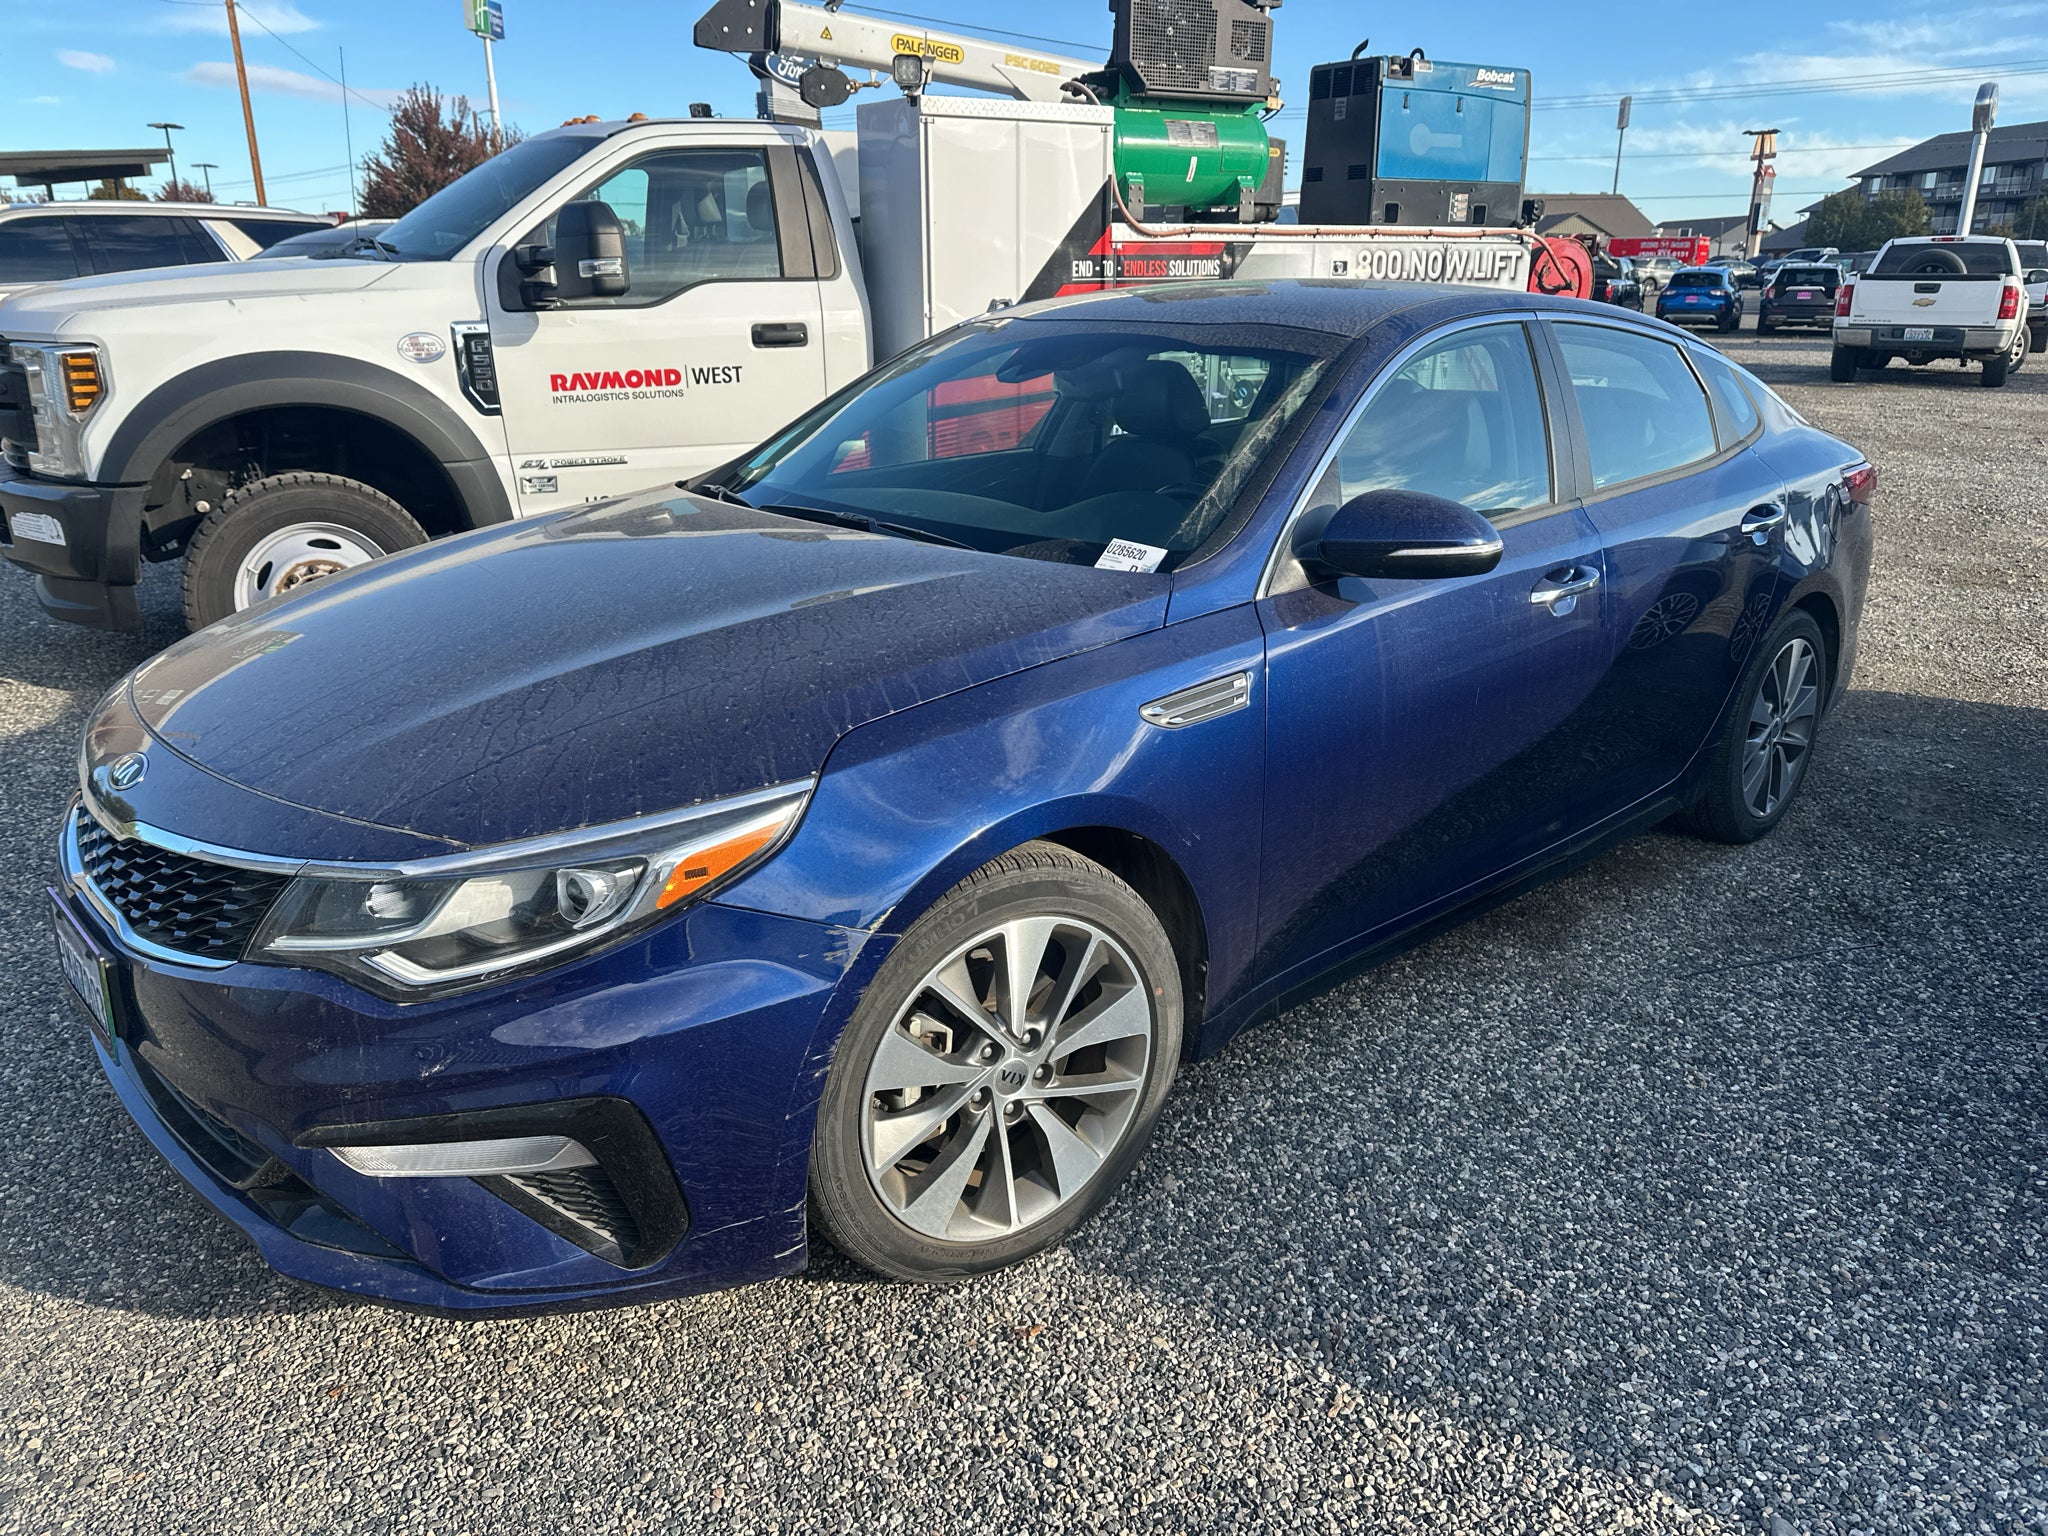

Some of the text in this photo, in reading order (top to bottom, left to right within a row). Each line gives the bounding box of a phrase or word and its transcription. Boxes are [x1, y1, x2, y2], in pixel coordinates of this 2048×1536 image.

[896, 37, 959, 61] PALFNGER
[1005, 53, 1061, 75] PSC 6025
[1476, 68, 1515, 84] Bobcat
[1072, 259, 1093, 277] END
[1124, 259, 1167, 276] ENDLESS
[1169, 259, 1220, 277] SOLUTIONS
[550, 365, 743, 392] RAYMOND WEST
[552, 389, 684, 404] INTRALOGISTICS SOLUTIONS
[554, 457, 587, 466] POWER
[589, 455, 626, 464] STROKE
[1106, 542, 1147, 561] U285620
[1001, 1069, 1026, 1087] KIA
